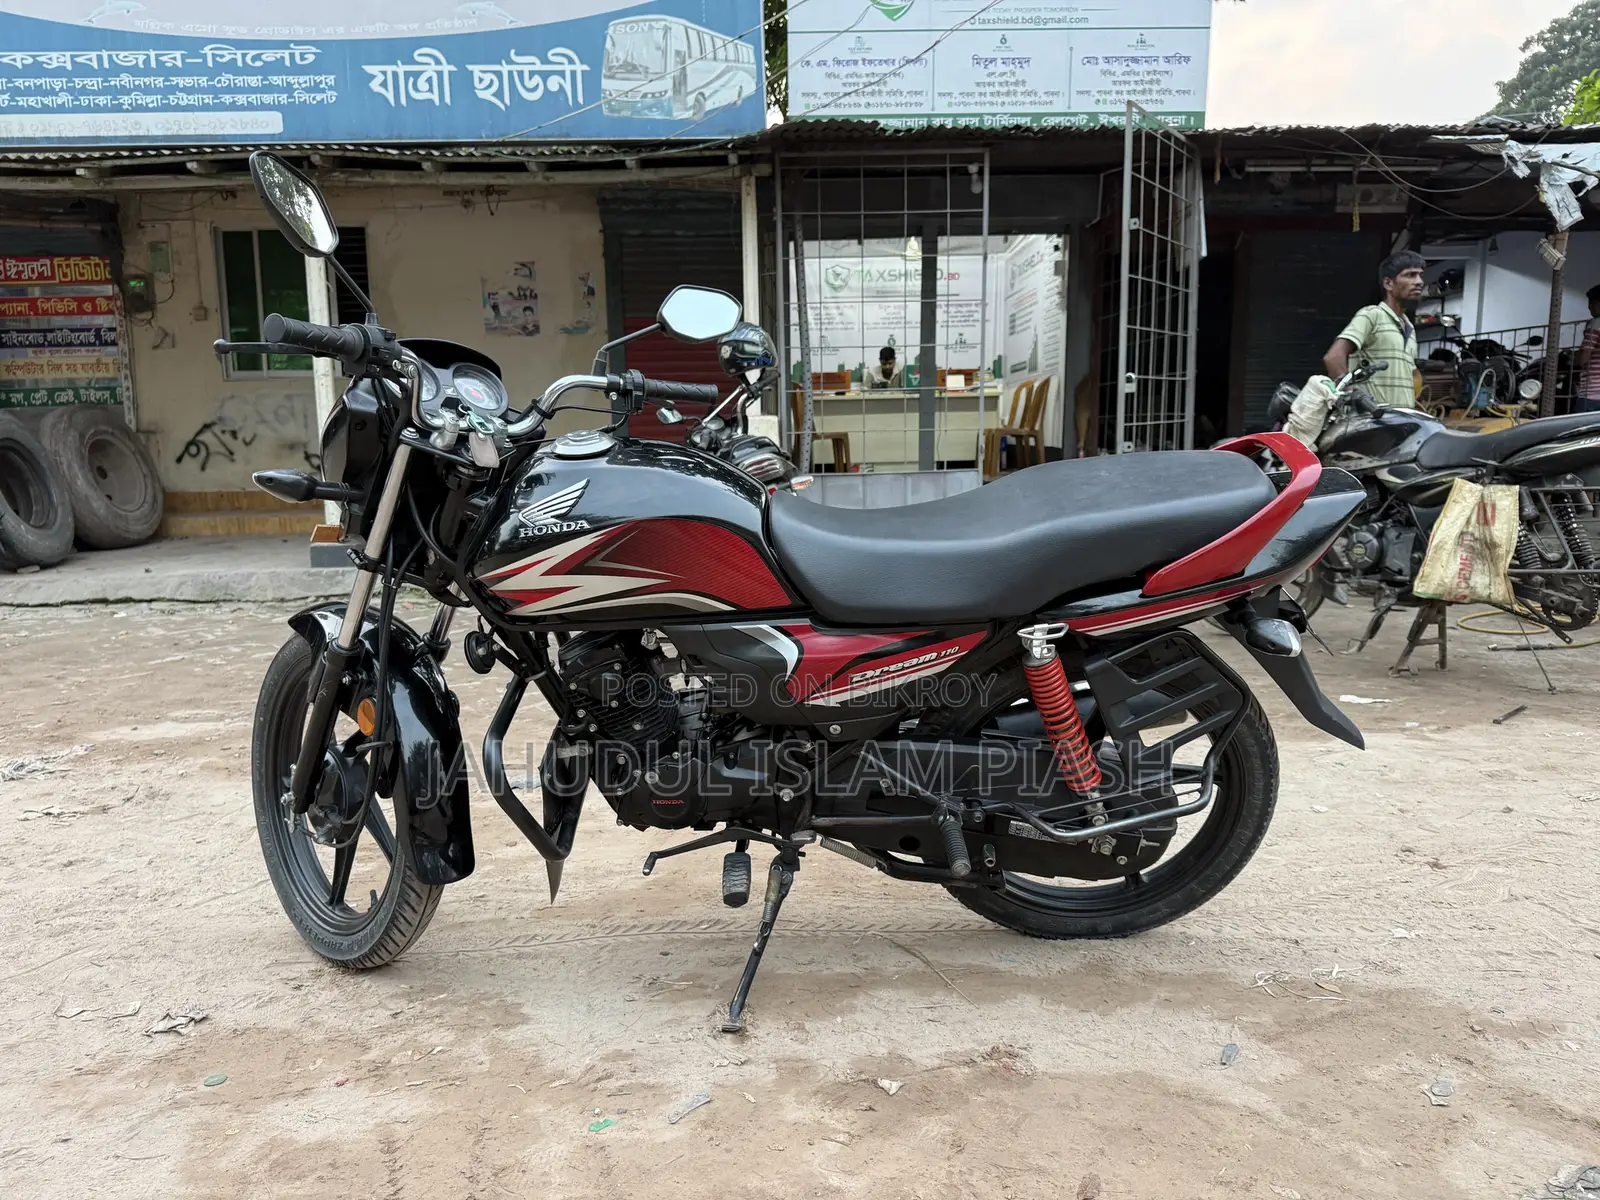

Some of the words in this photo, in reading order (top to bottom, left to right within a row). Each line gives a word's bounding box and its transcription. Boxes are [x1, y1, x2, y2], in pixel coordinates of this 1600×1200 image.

[978, 14, 1089, 26] taxshield.bd@gmail.com
[0, 44, 322, 70] কক্সবাজার-সিলেট
[972, 54, 998, 69] মিতুল
[1081, 56, 1099, 66] মোঃ
[1102, 56, 1160, 67] আসাদুজ্জামান
[1162, 52, 1192, 65] আরিফ
[362, 47, 458, 108] যাত্রী
[465, 47, 591, 112] ছাউনী
[956, 117, 981, 127] বাস
[5, 259, 51, 280] ঈশ্বরদী
[37, 299, 78, 315] পিভিসি
[82, 303, 92, 313] ও
[519, 519, 591, 538] HONDA
[1456, 535, 1475, 590] CEMET
[850, 652, 938, 682] Dream
[940, 646, 960, 657] 110
